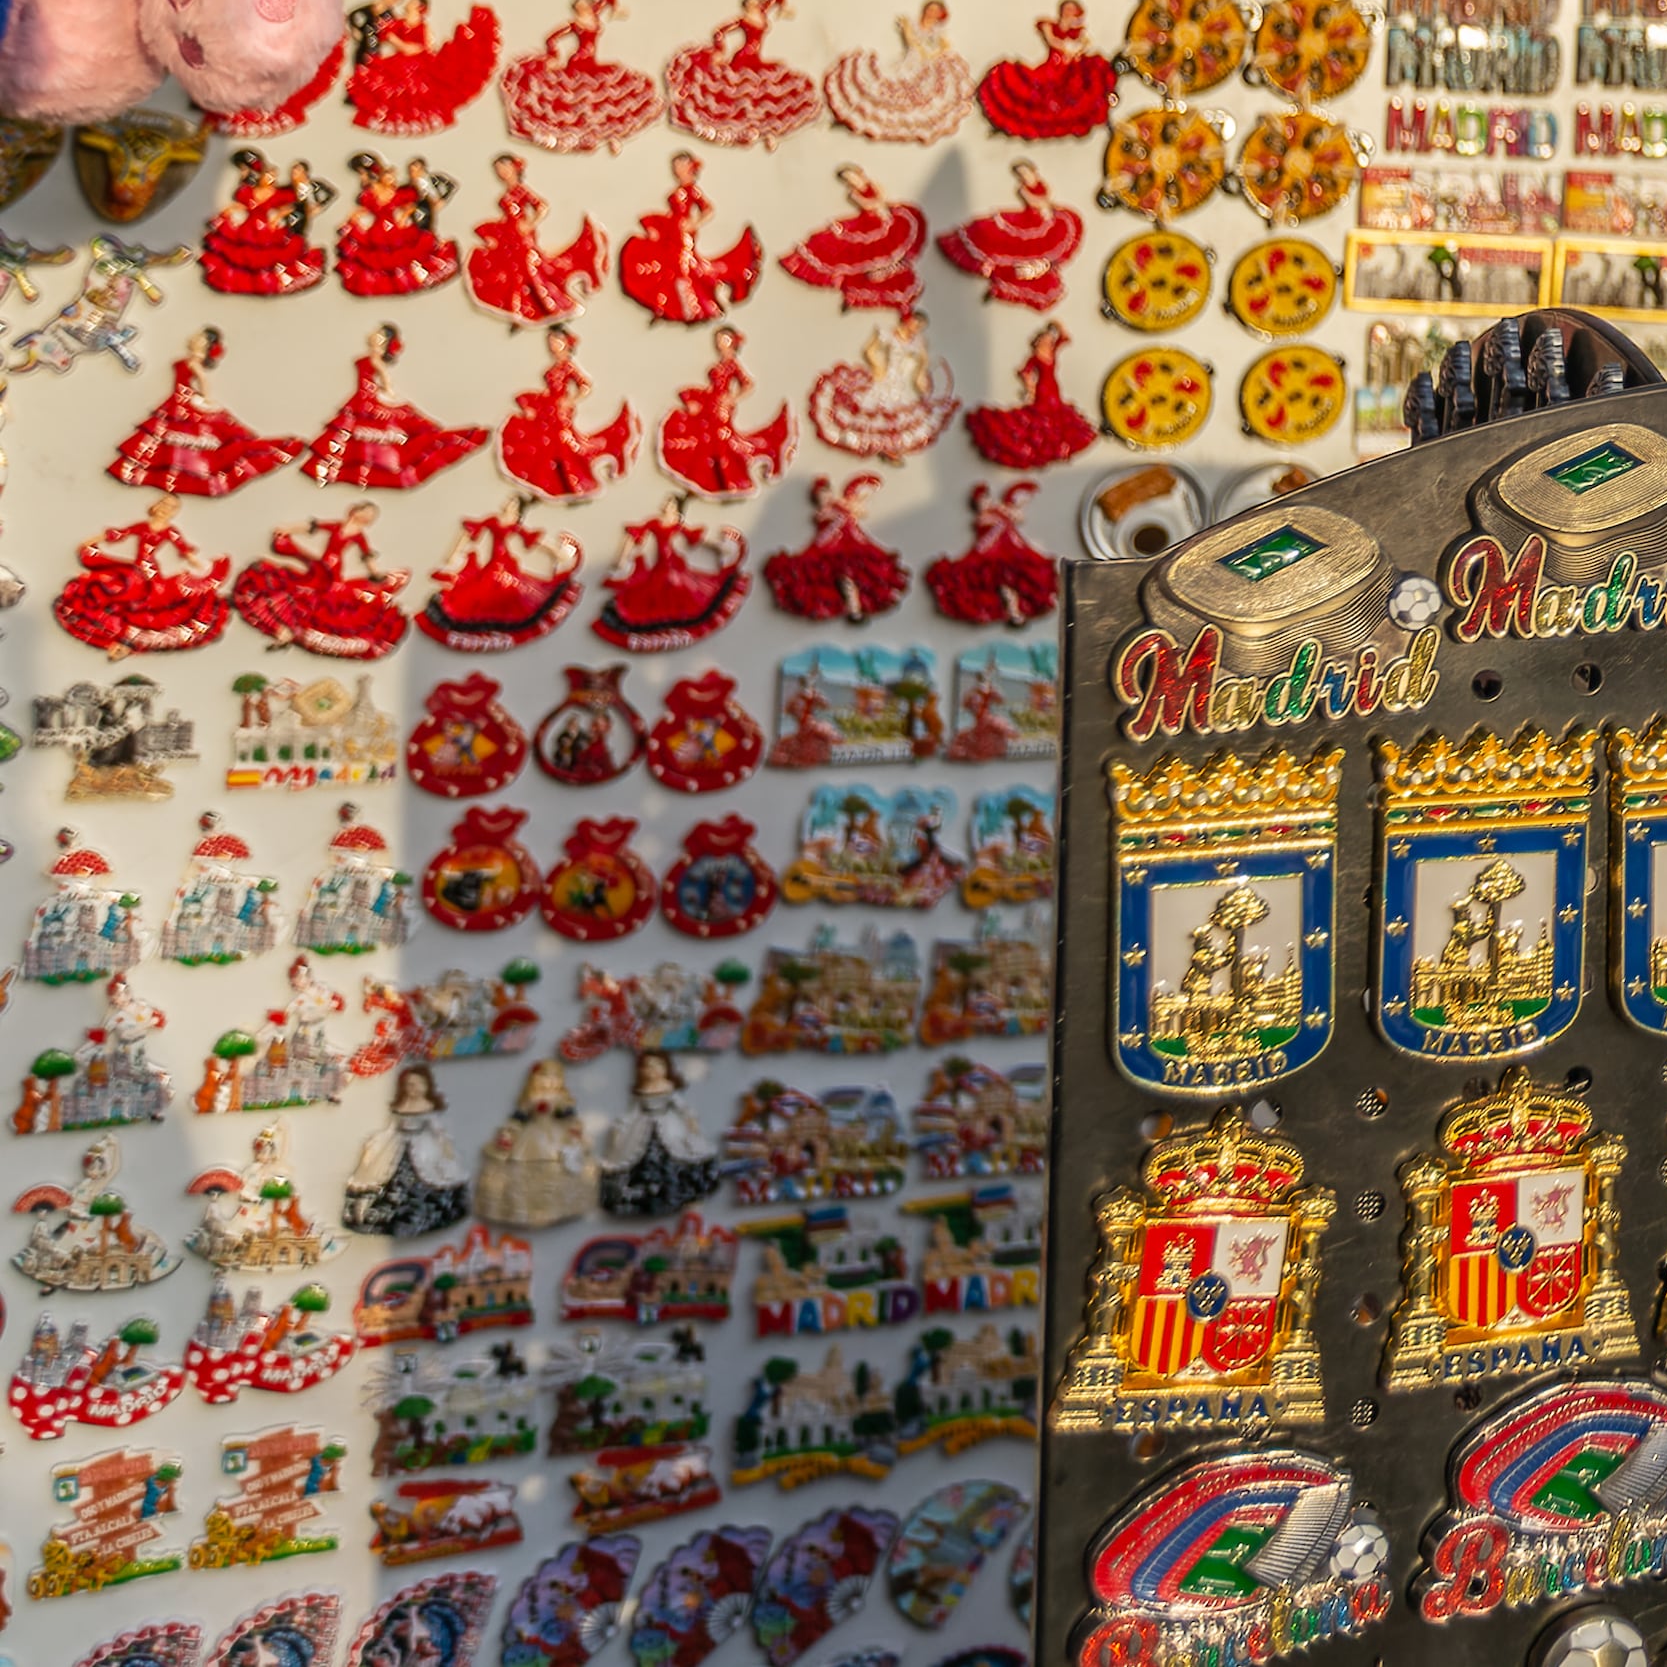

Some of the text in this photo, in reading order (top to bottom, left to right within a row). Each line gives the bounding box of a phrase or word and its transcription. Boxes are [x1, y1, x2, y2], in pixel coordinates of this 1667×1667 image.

[1117, 624, 1441, 741] Madrid
[1422, 1023, 1540, 1056] MADRID
[1162, 1051, 1288, 1087] MADRID
[757, 1287, 921, 1338] MADRID
[1442, 1336, 1589, 1377] ESPAÑA
[1115, 1390, 1269, 1425] ESPAÑA
